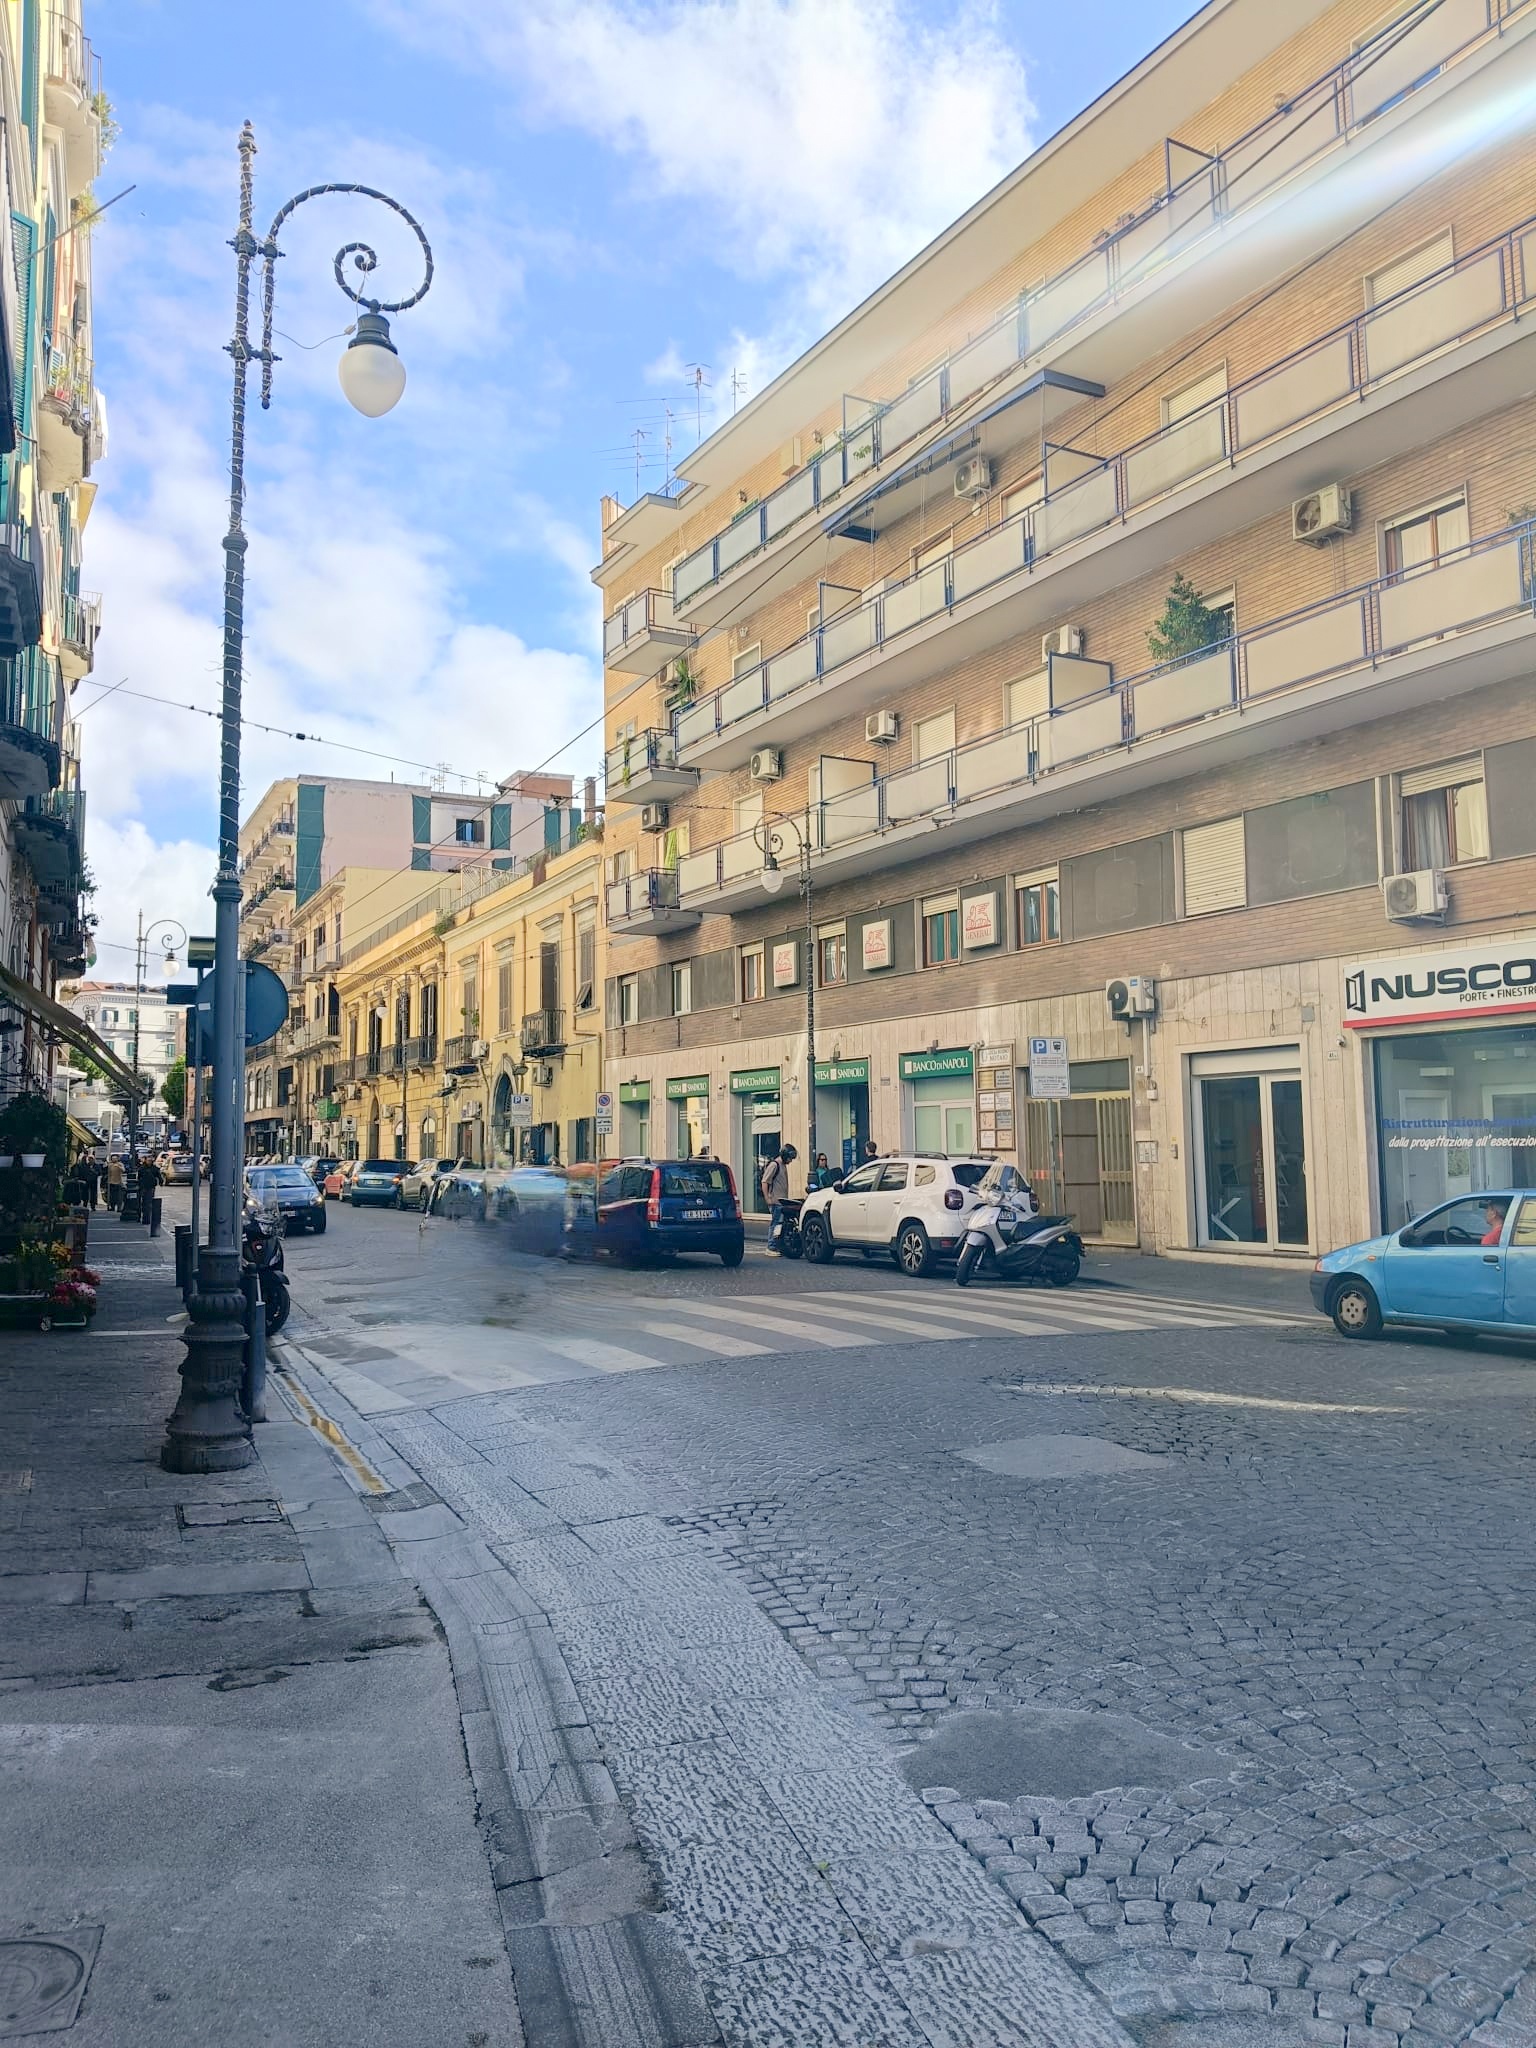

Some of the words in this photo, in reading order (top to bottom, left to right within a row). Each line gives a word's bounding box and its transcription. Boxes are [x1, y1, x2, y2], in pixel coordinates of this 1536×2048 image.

[965, 927, 992, 940] GENERALI
[1371, 958, 1536, 1002] NUSCO
[1459, 991, 1488, 1003] PORTE
[912, 1060, 936, 1072] BANCO
[942, 1056, 968, 1070] NAPOLI
[815, 1070, 830, 1080] NTESA
[1388, 1135, 1410, 1148] dalla
[1409, 1135, 1474, 1151] progettazione
[1475, 1133, 1536, 1147] all'esecuzio
